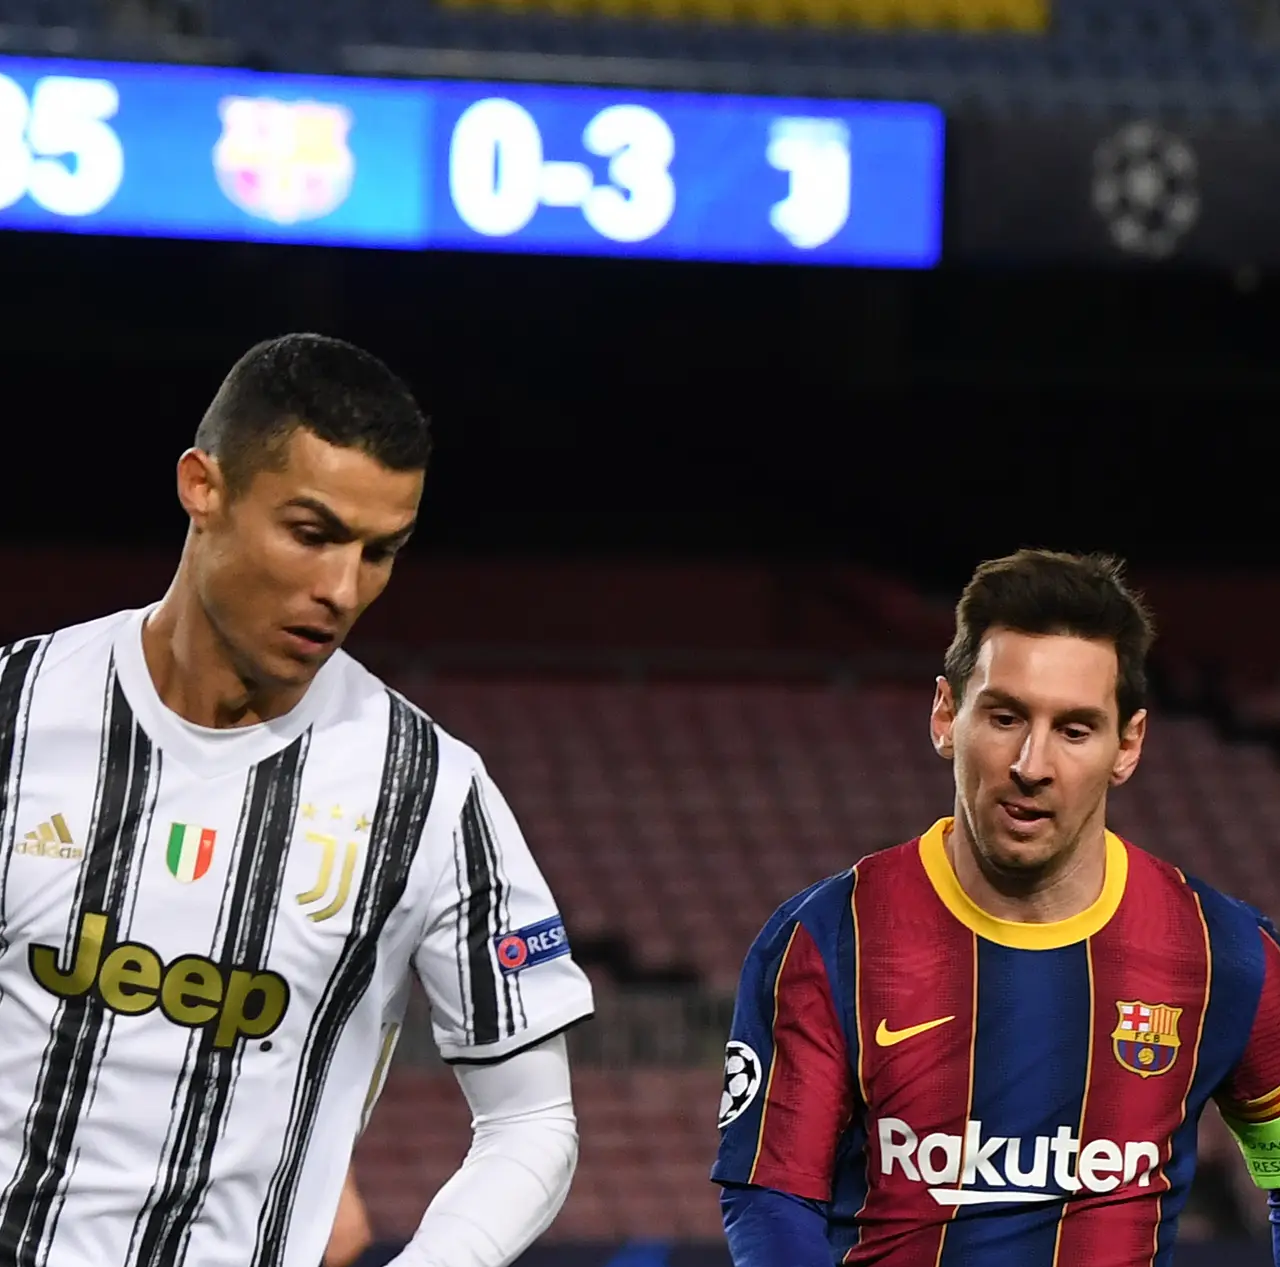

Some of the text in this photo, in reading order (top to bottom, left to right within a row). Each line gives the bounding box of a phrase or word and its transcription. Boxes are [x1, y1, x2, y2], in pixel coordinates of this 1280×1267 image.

[448, 97, 676, 242] 0-3
[15, 842, 83, 859] adidas
[28, 906, 291, 1052] Jeep
[877, 1117, 1160, 1194] Rakuten
